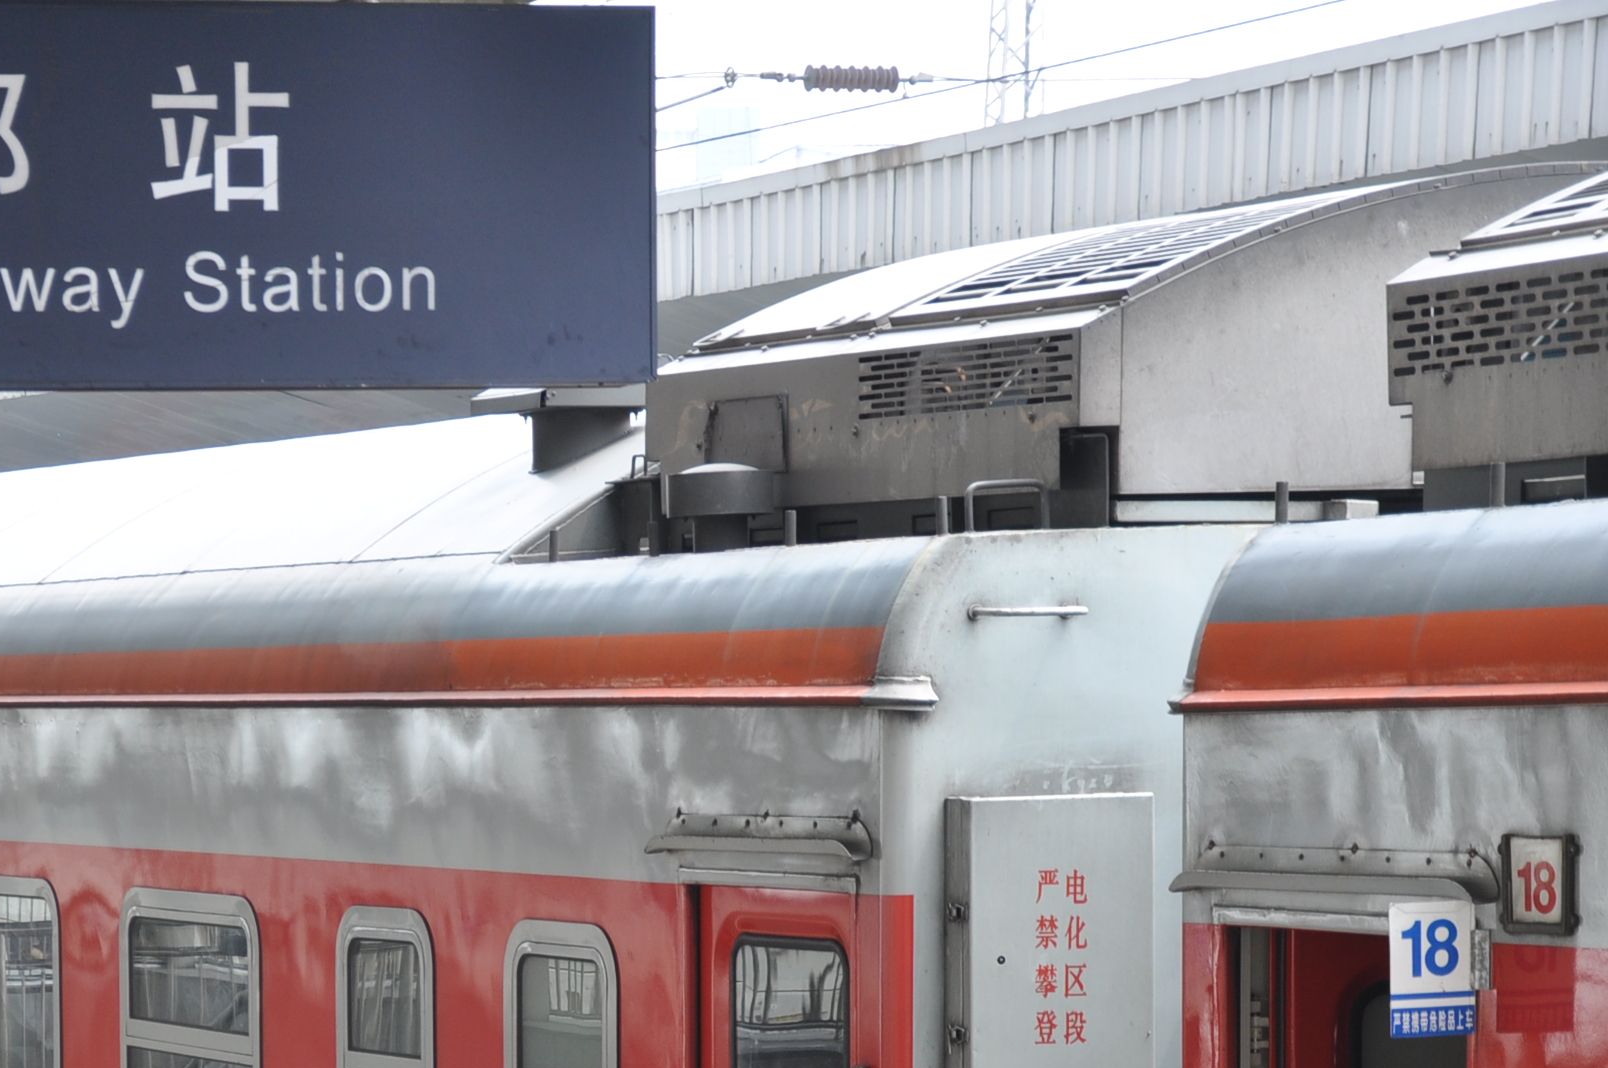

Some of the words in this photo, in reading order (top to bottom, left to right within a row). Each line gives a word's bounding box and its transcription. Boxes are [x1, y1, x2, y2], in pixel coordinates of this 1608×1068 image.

[182, 249, 435, 313] Station
[1517, 860, 1557, 915] 18
[1035, 869, 1059, 1045] 严禁攀登
[1064, 869, 1088, 1045] 电化区段
[1401, 918, 1459, 978] 18
[1392, 1008, 1474, 1035] 严禁携带危险品上车
